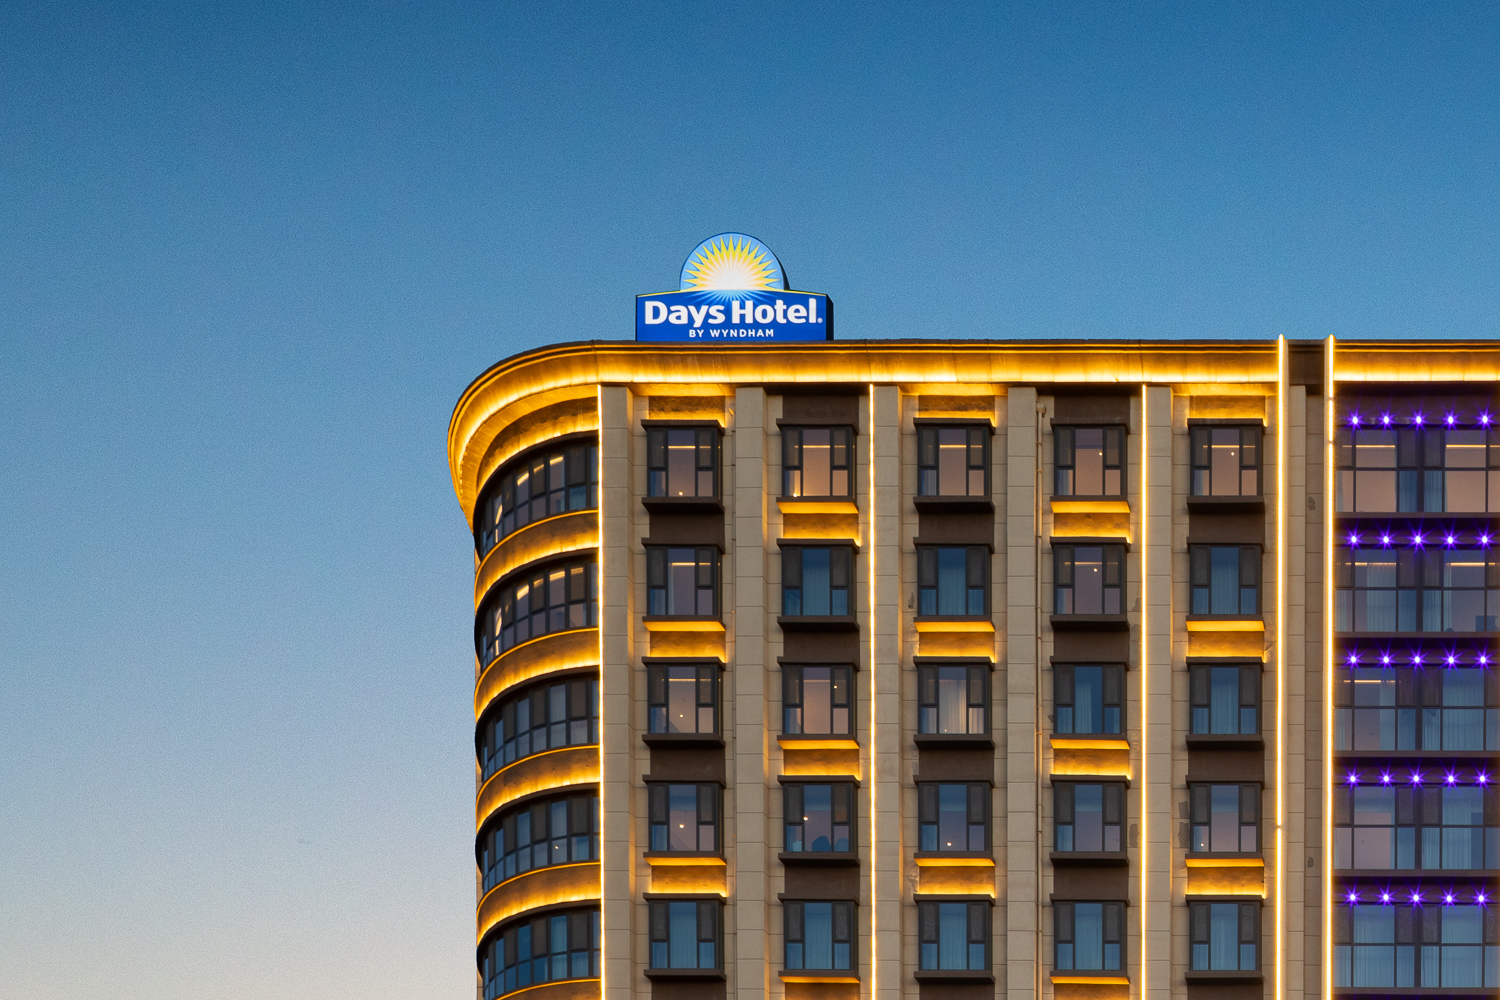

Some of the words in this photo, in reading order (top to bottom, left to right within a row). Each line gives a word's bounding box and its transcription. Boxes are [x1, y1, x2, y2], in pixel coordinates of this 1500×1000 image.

[644, 300, 726, 328] Days
[689, 329, 705, 338] BY
[710, 329, 774, 338] WYNDHAM
